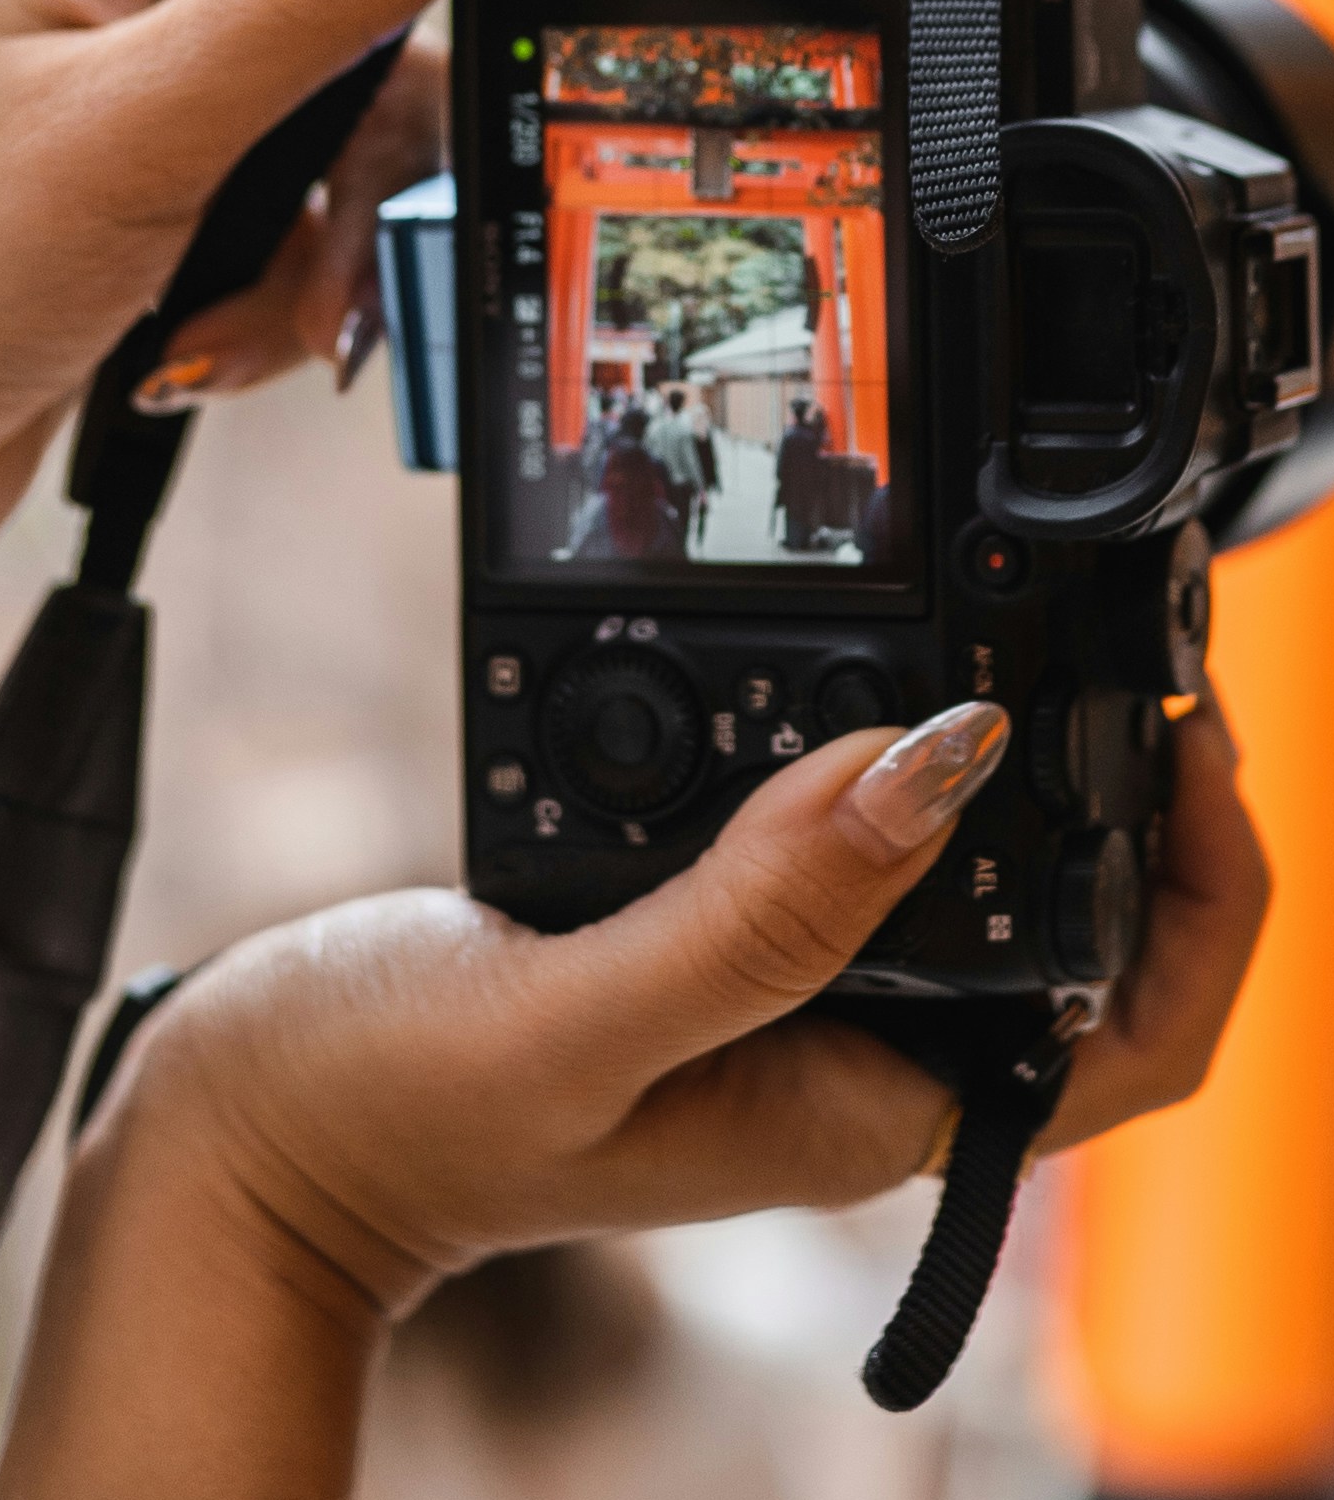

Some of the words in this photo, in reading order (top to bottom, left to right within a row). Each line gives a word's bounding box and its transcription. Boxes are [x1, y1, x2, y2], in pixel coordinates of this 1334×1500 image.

[750, 679, 772, 709] Fn
[714, 712, 736, 755] DISP
[534, 799, 562, 836] C4
[973, 857, 997, 898] AEL
